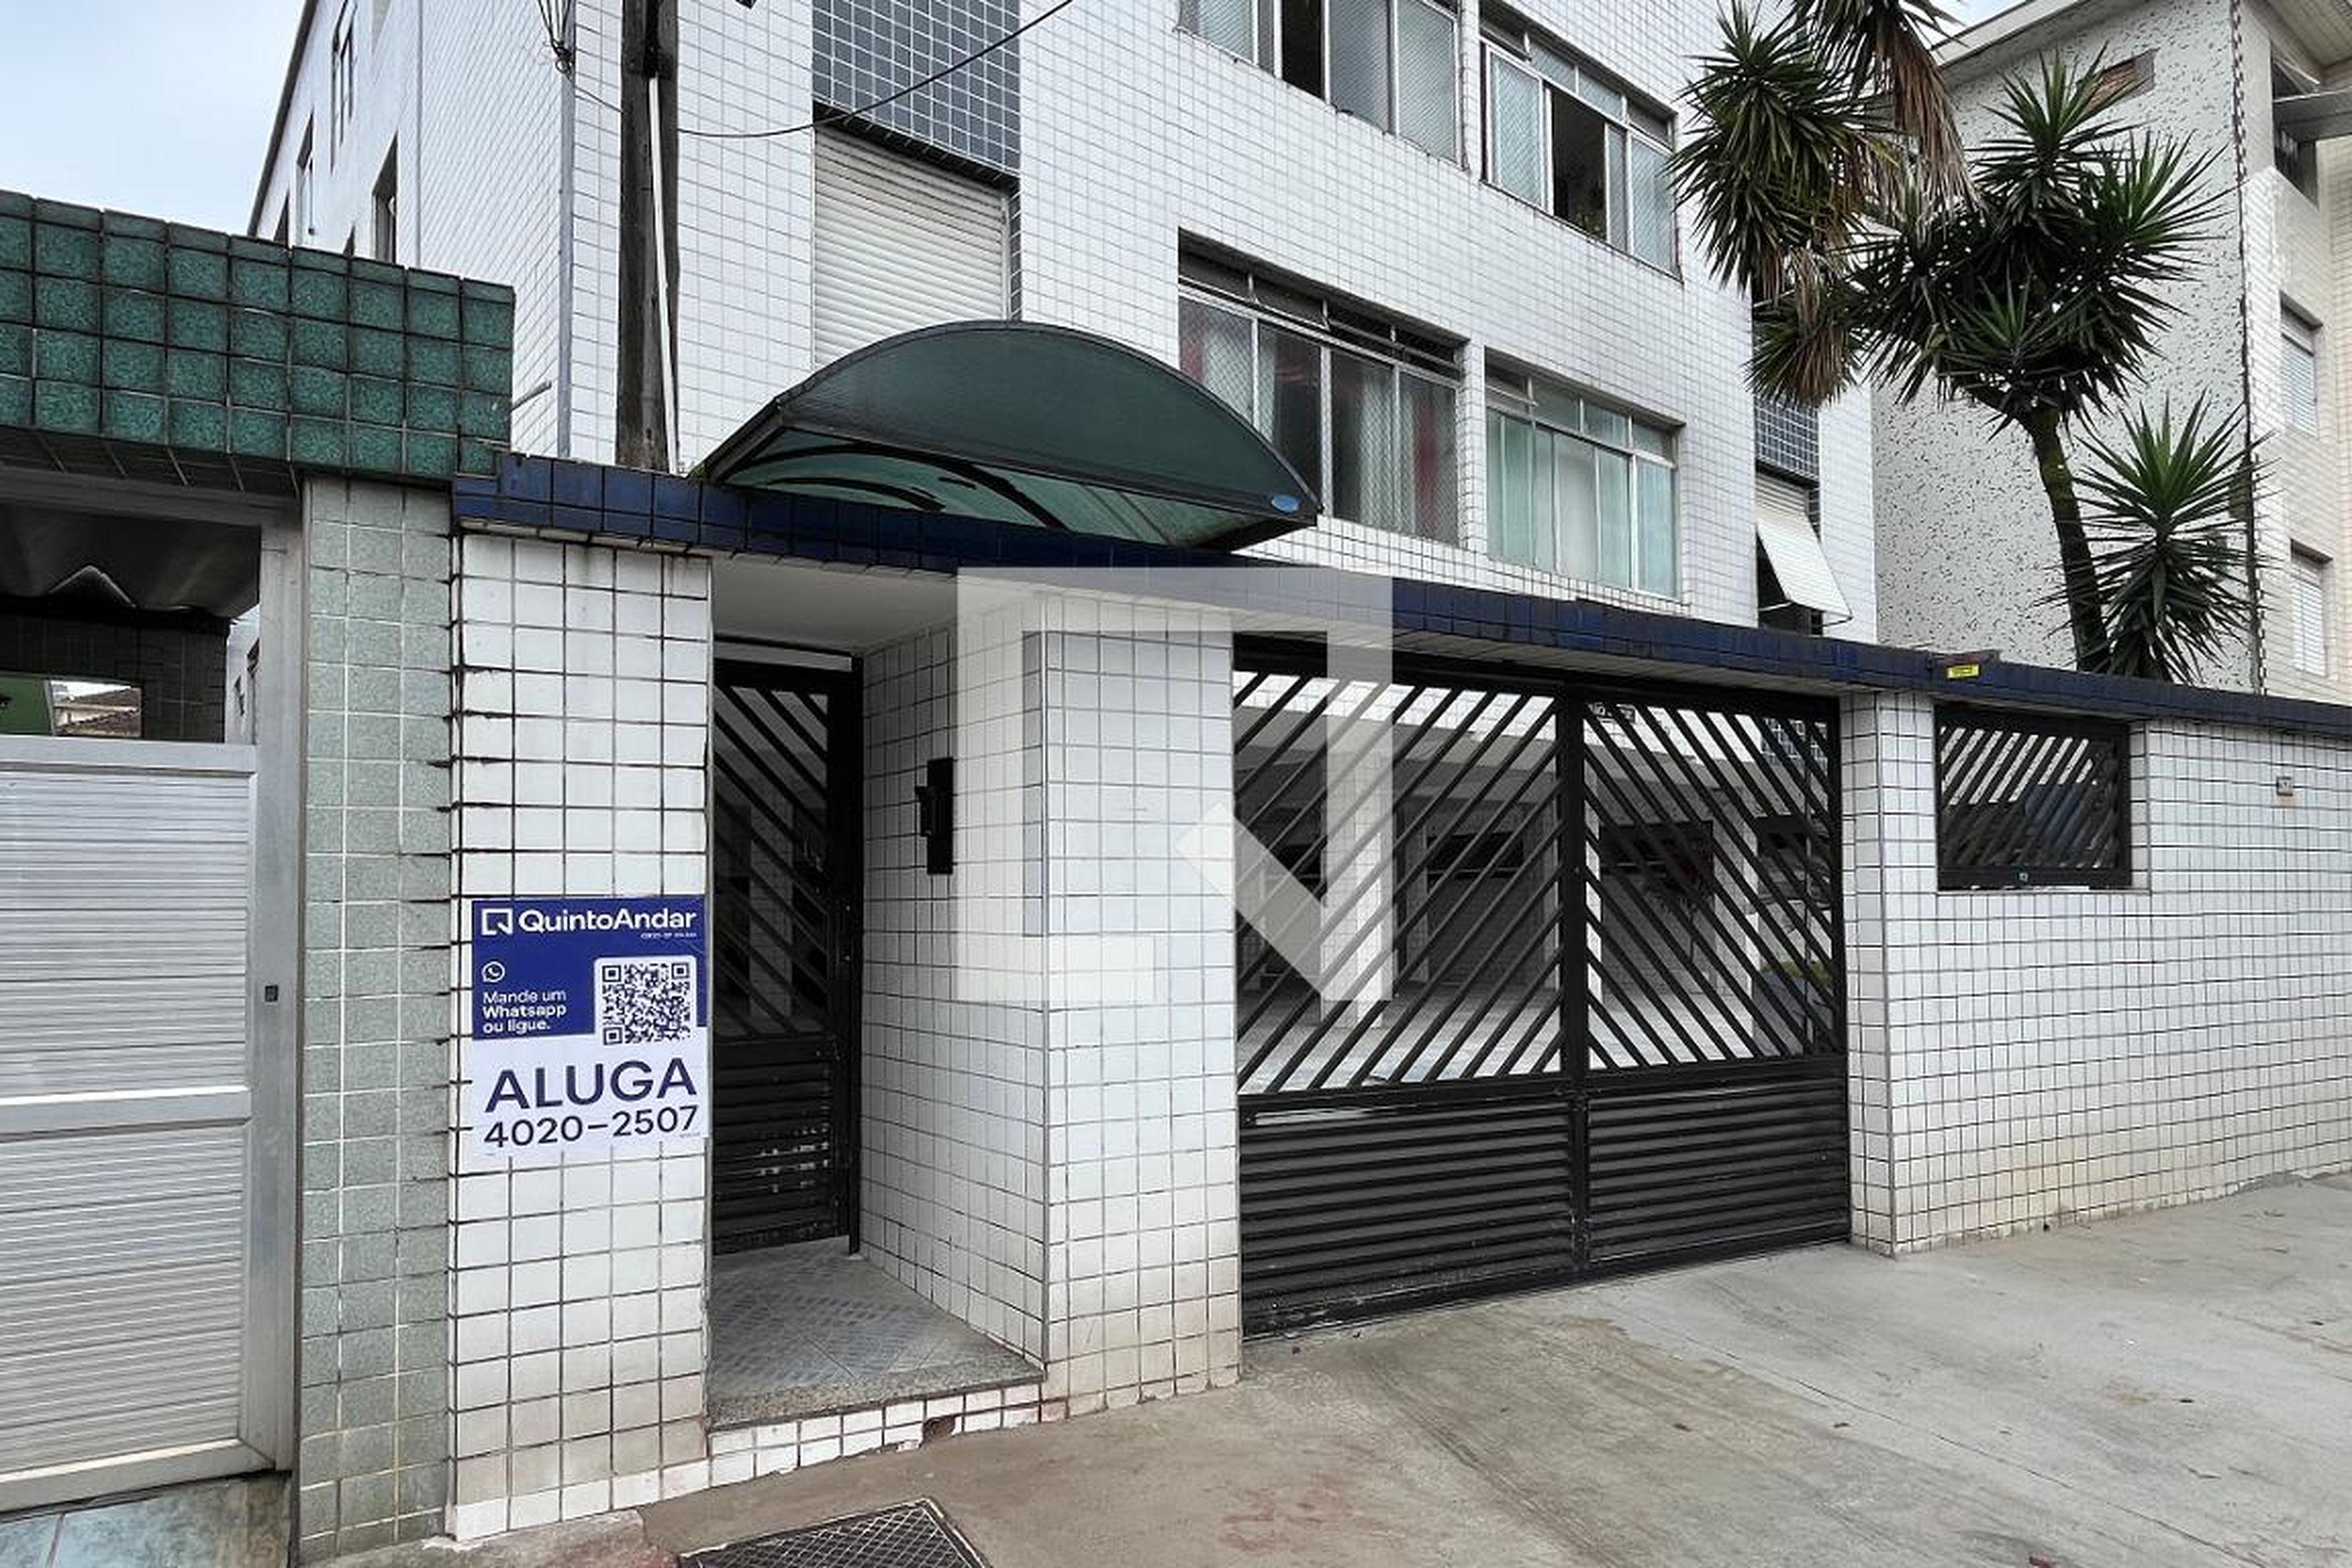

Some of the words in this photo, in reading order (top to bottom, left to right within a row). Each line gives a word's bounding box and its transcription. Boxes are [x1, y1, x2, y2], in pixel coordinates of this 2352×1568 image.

[519, 908, 697, 933] QuintoAndar
[483, 990, 538, 1004] Mande
[542, 990, 567, 1002] um
[483, 1005, 567, 1019] Whatsapp
[483, 1022, 503, 1033] ou
[507, 1019, 551, 1035] ligue.
[484, 1057, 697, 1113] ALUGA
[483, 1104, 699, 1148] 4020-2507
